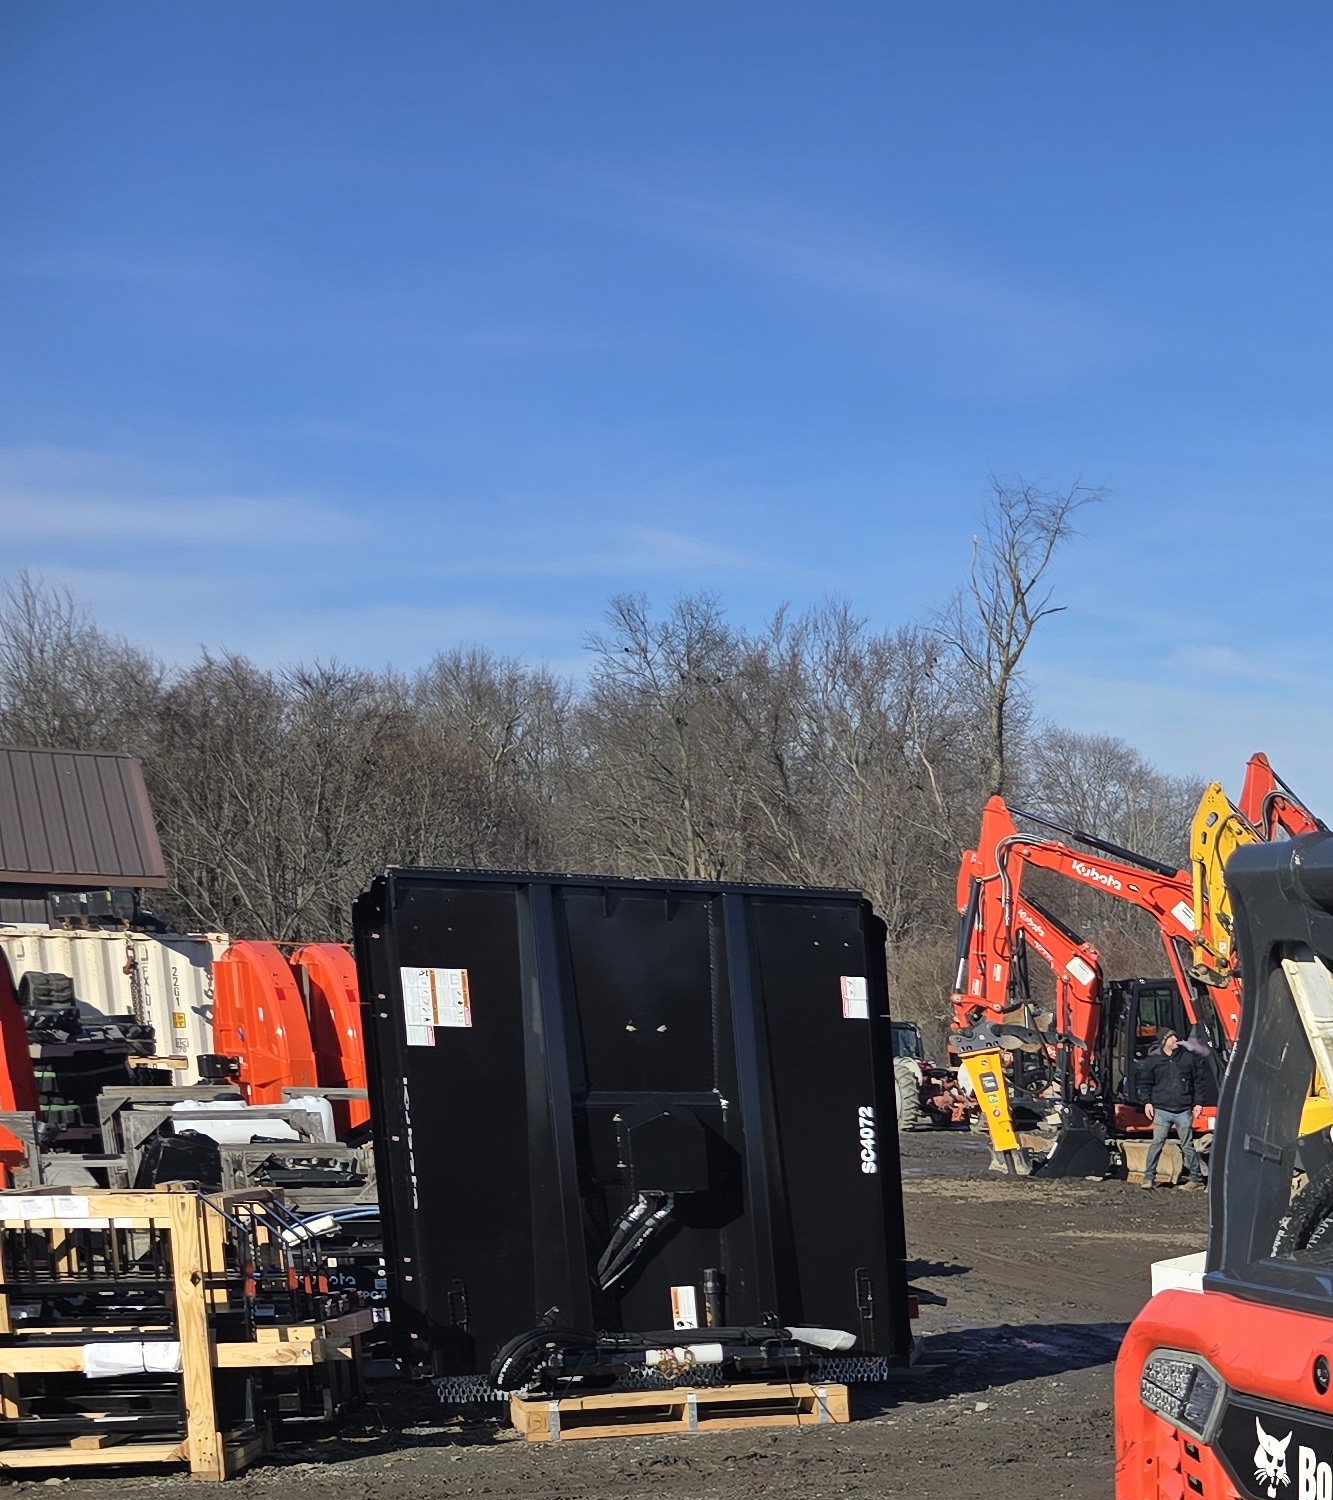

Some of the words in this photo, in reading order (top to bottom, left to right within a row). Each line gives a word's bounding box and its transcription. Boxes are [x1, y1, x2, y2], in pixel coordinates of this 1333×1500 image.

[1072, 860, 1122, 891] Kubota
[171, 966, 181, 1006] 22G1
[859, 1106, 877, 1174] SC4072
